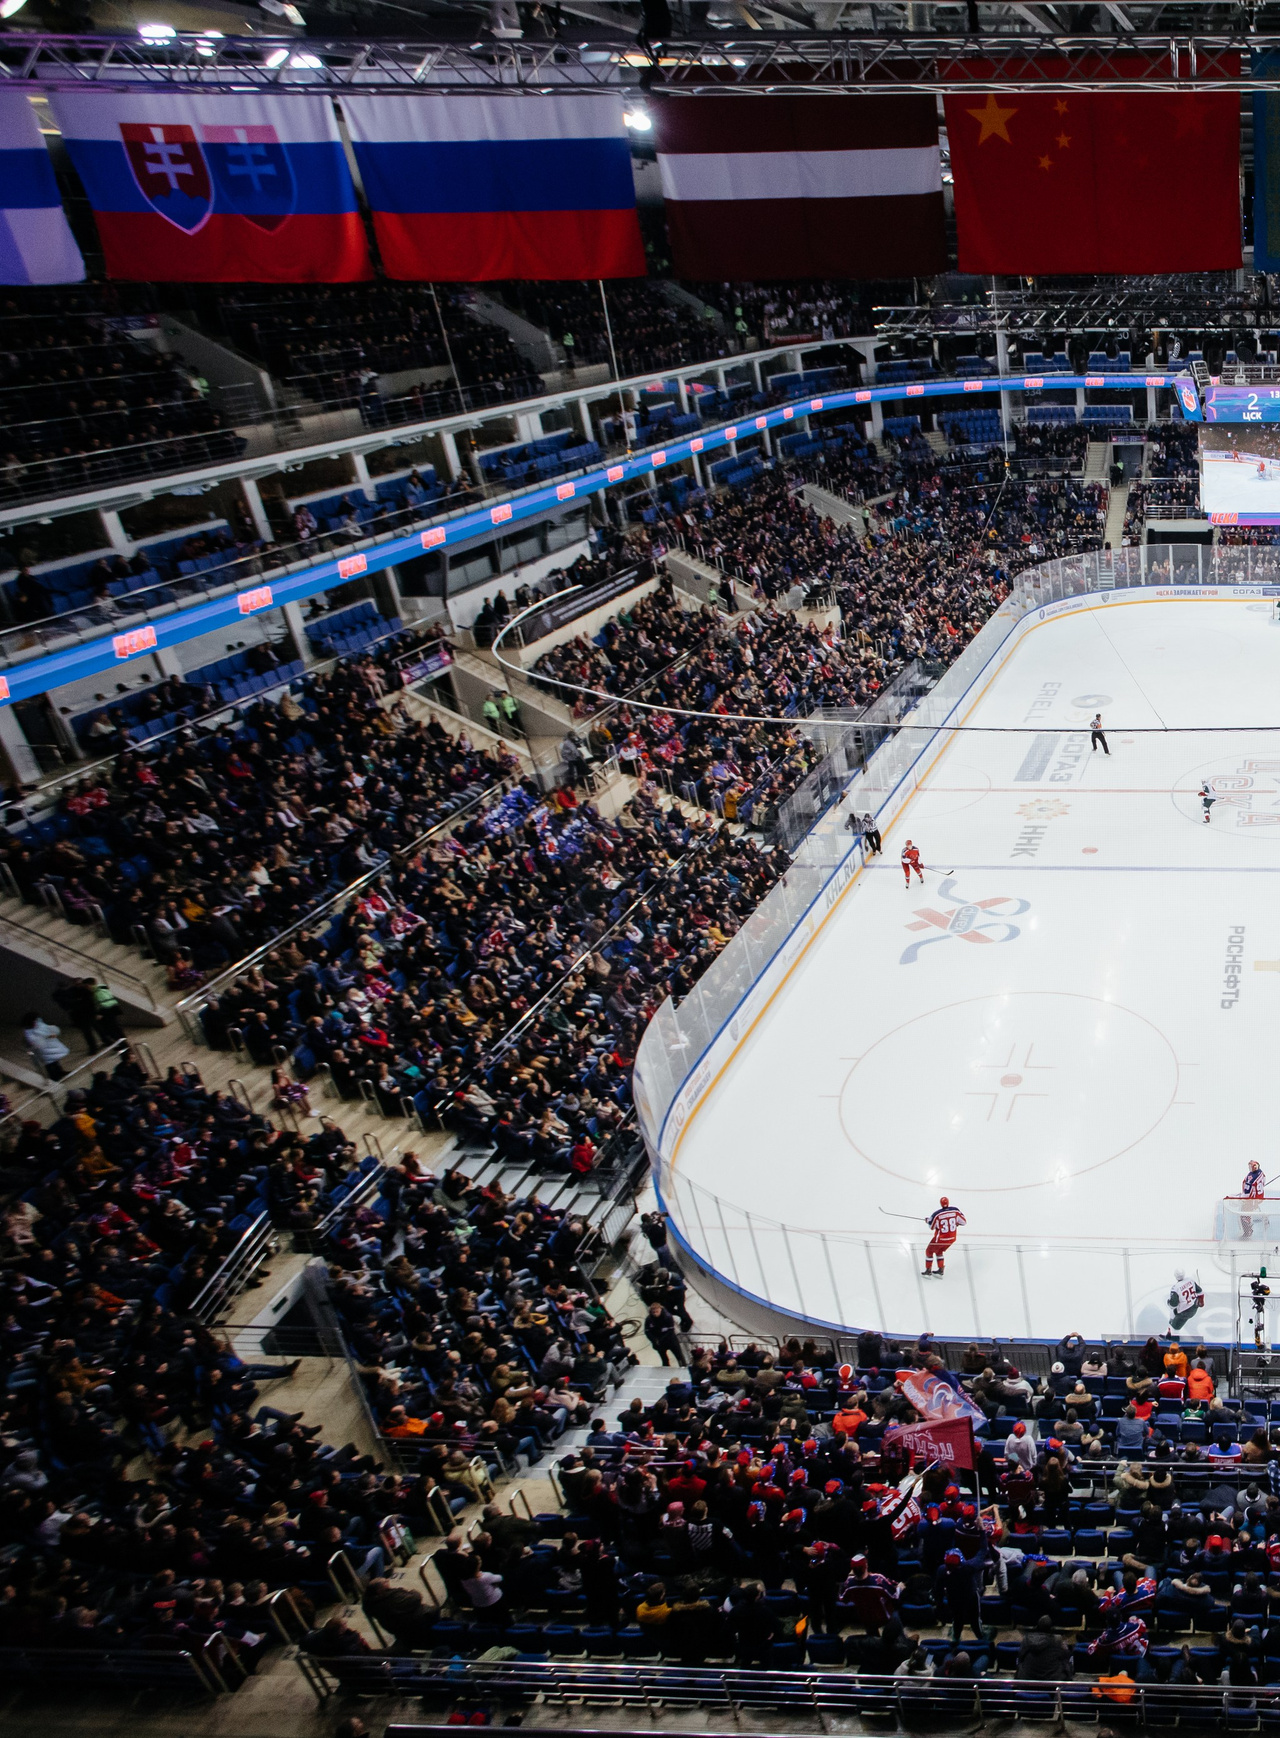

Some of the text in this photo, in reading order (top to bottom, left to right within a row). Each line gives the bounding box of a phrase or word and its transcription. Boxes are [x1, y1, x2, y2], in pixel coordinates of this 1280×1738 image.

[1247, 393, 1259, 411] 2
[1242, 411, 1262, 421] ЦСК
[1211, 512, 1238, 525] ЦСКА
[1022, 682, 1063, 724] ERIELL
[1049, 733, 1090, 783] СОГАЗ
[824, 849, 858, 910] KHL.RU
[953, 905, 978, 934] durex
[1220, 925, 1246, 1010] РОСНЕФТЬ
[940, 1217, 957, 1234] 38
[1181, 1286, 1198, 1305] 25
